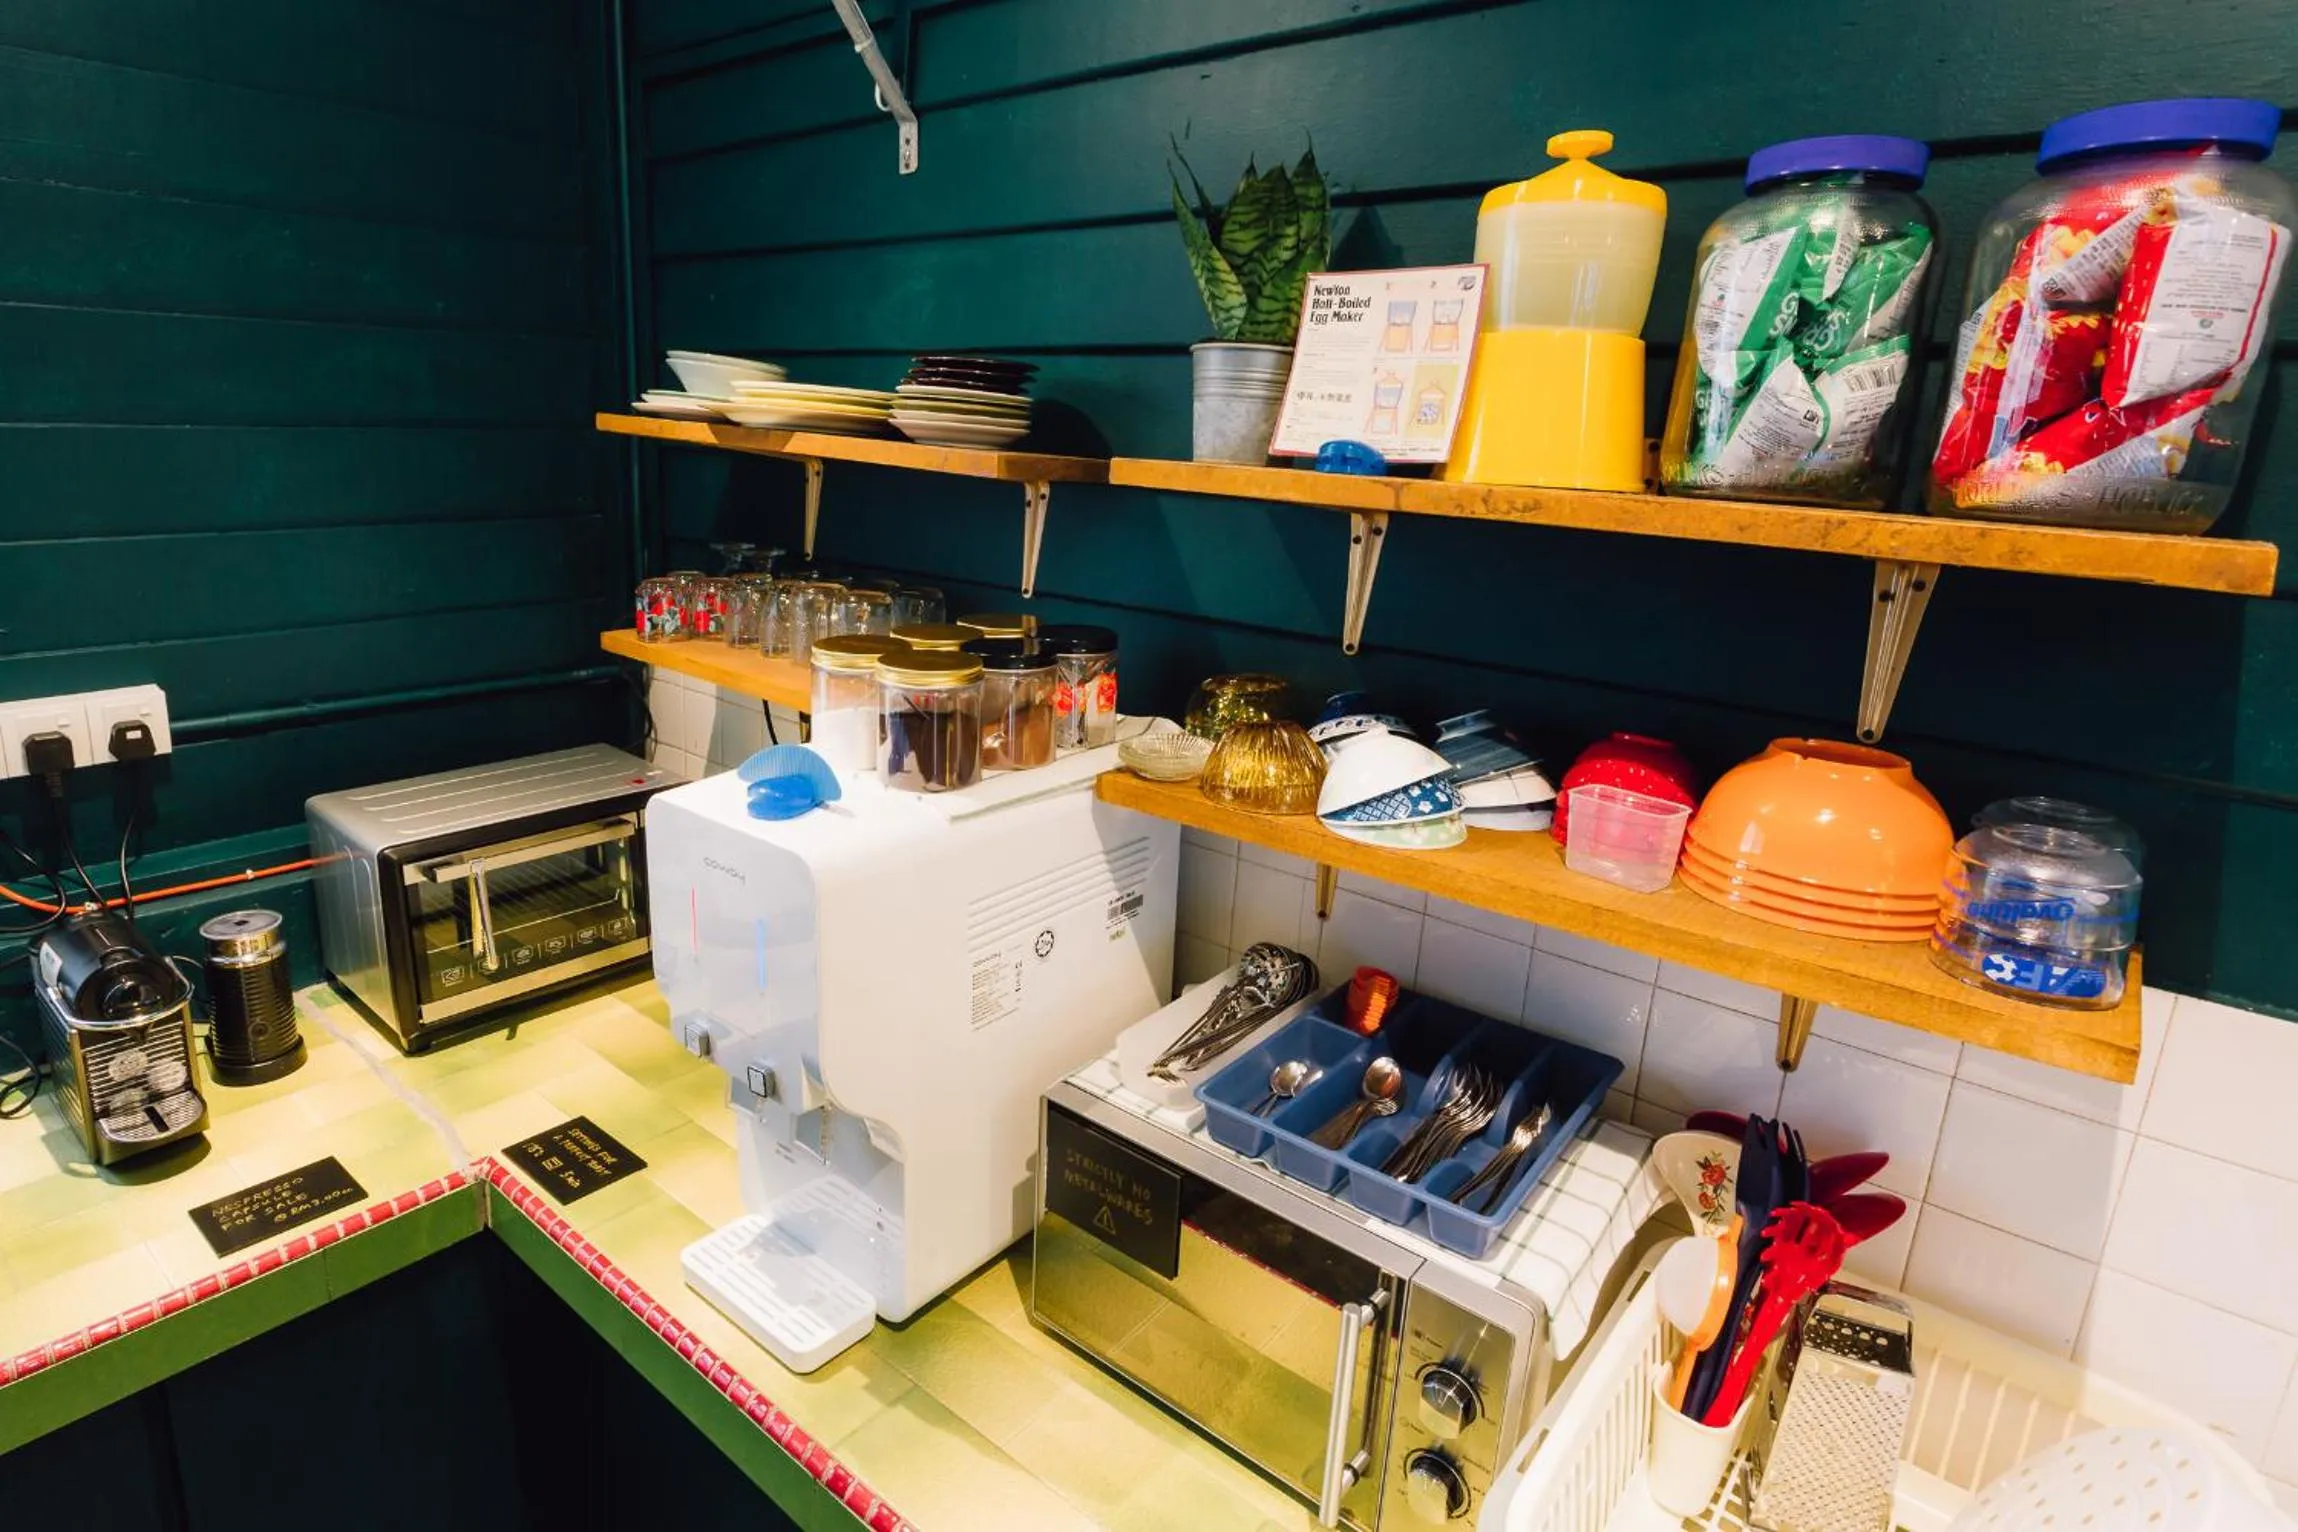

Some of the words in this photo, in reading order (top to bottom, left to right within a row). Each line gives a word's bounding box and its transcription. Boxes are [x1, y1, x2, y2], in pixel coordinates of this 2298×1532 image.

[1309, 312, 1328, 325] Egg
[1330, 310, 1364, 323] Maker
[212, 1177, 303, 1217] NESPRESSO
[1132, 1181, 1151, 1200] NO
[221, 1214, 256, 1231] FOR
[265, 1194, 307, 1216] SALE
